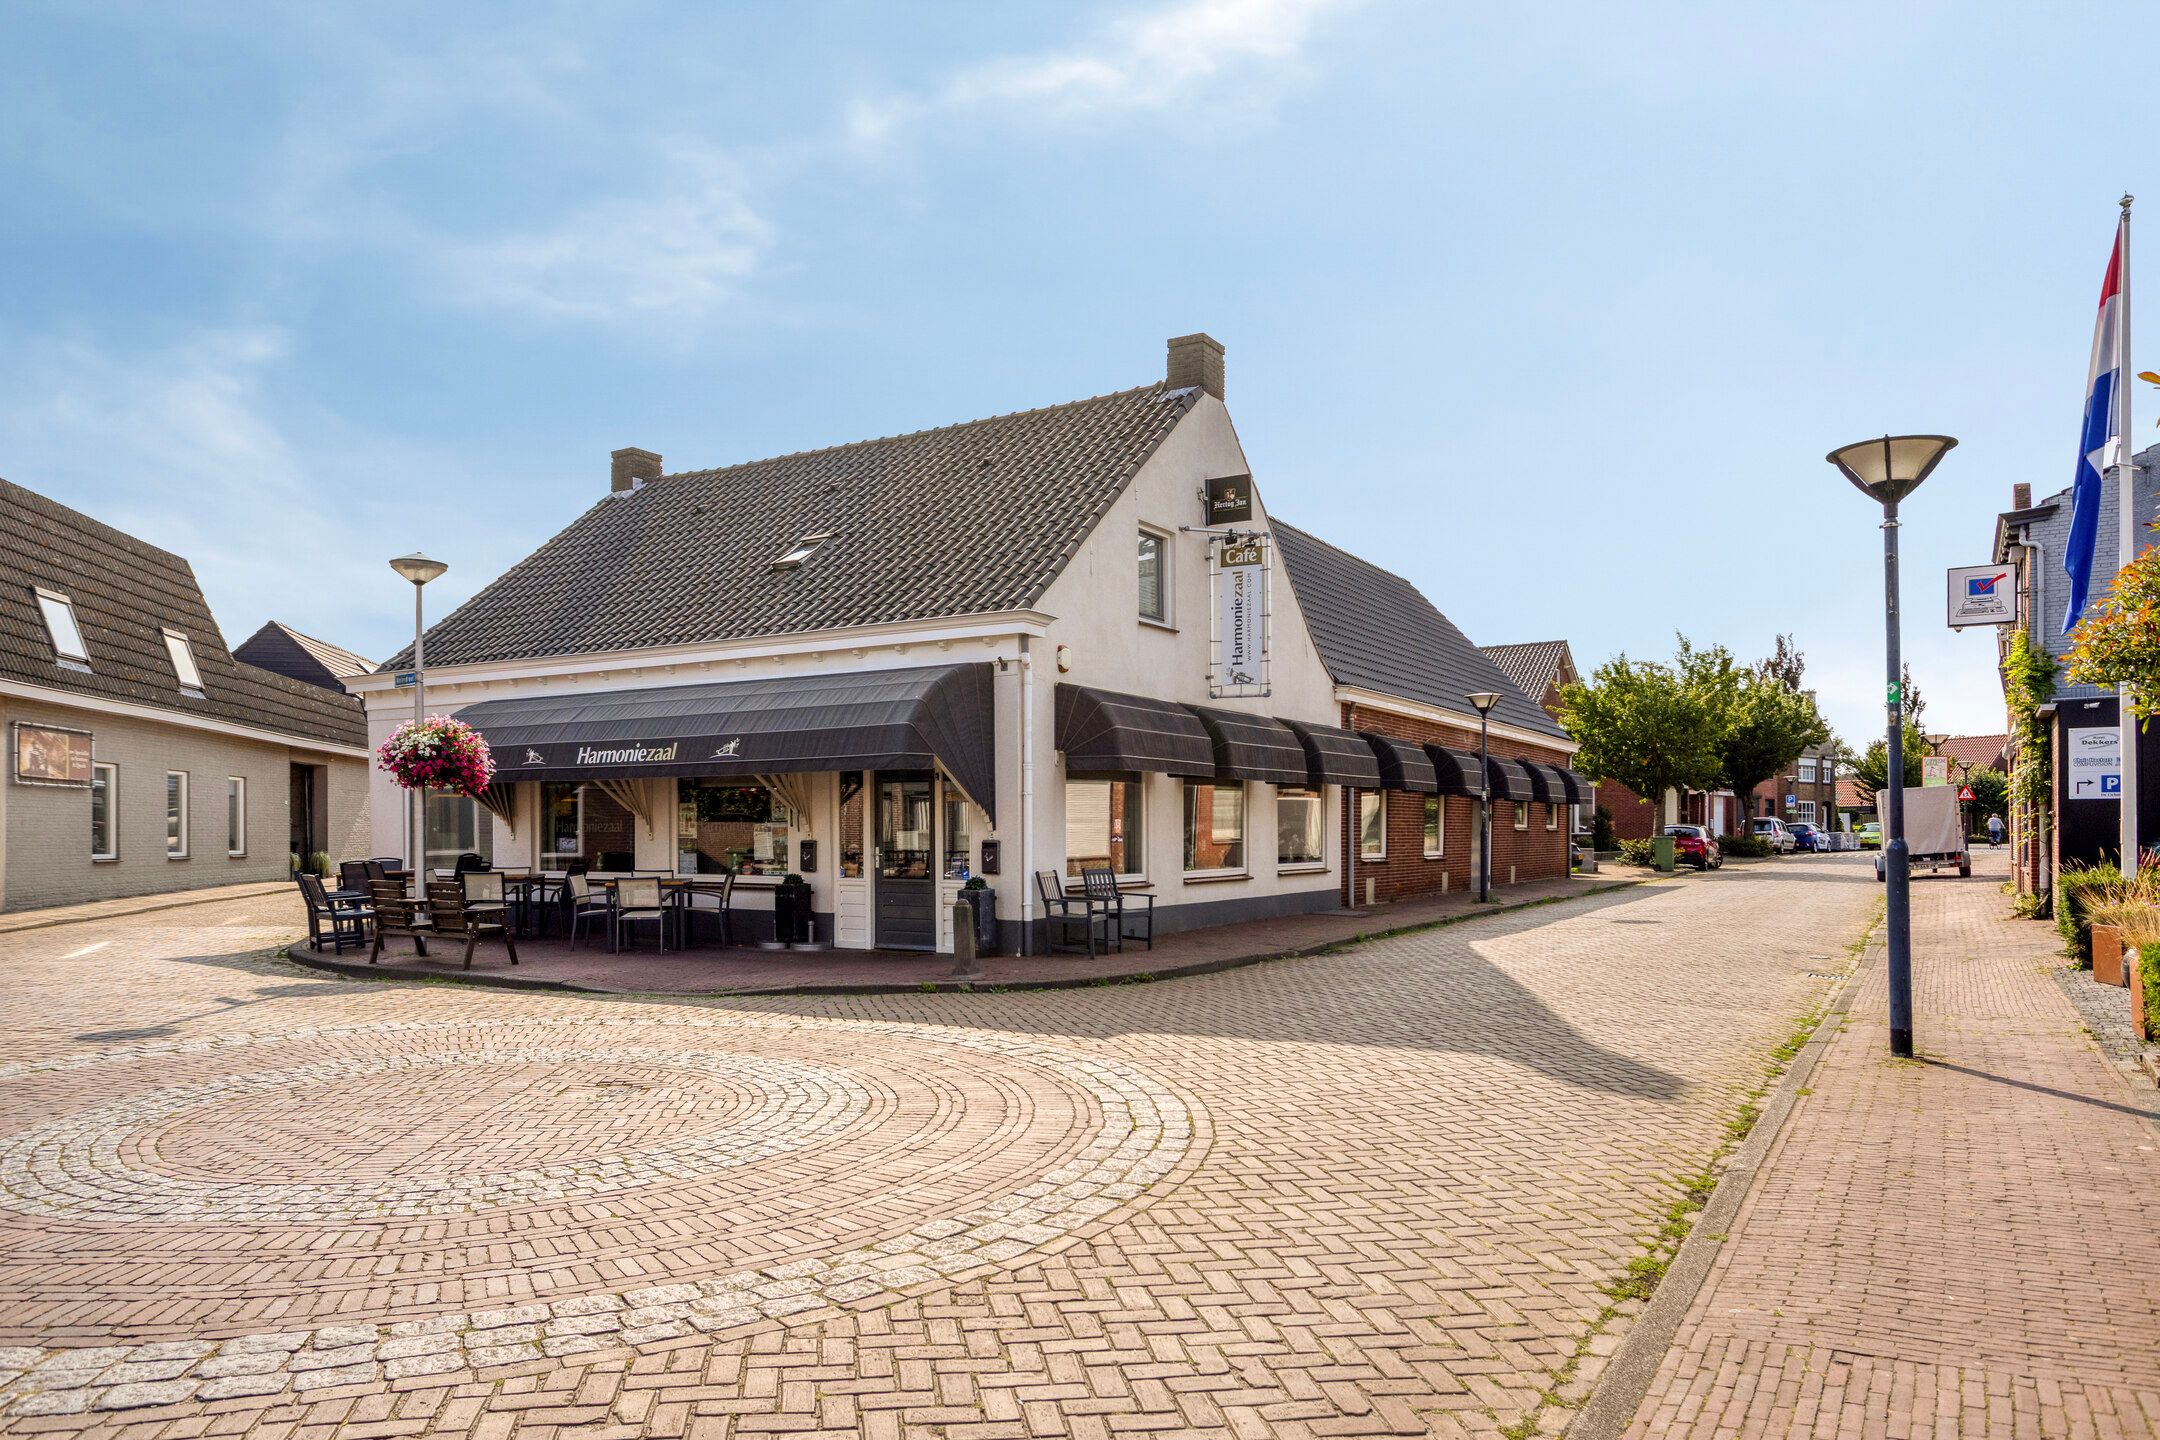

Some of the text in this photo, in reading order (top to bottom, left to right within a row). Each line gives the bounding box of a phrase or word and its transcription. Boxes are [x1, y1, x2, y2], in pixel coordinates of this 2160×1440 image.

[1214, 498, 1247, 509] Hertog Jan
[1225, 547, 1257, 564] Café
[1231, 571, 1243, 666] Harmoniezaal
[577, 742, 678, 764] Harmoniezaal
[2106, 777, 2119, 789] P
